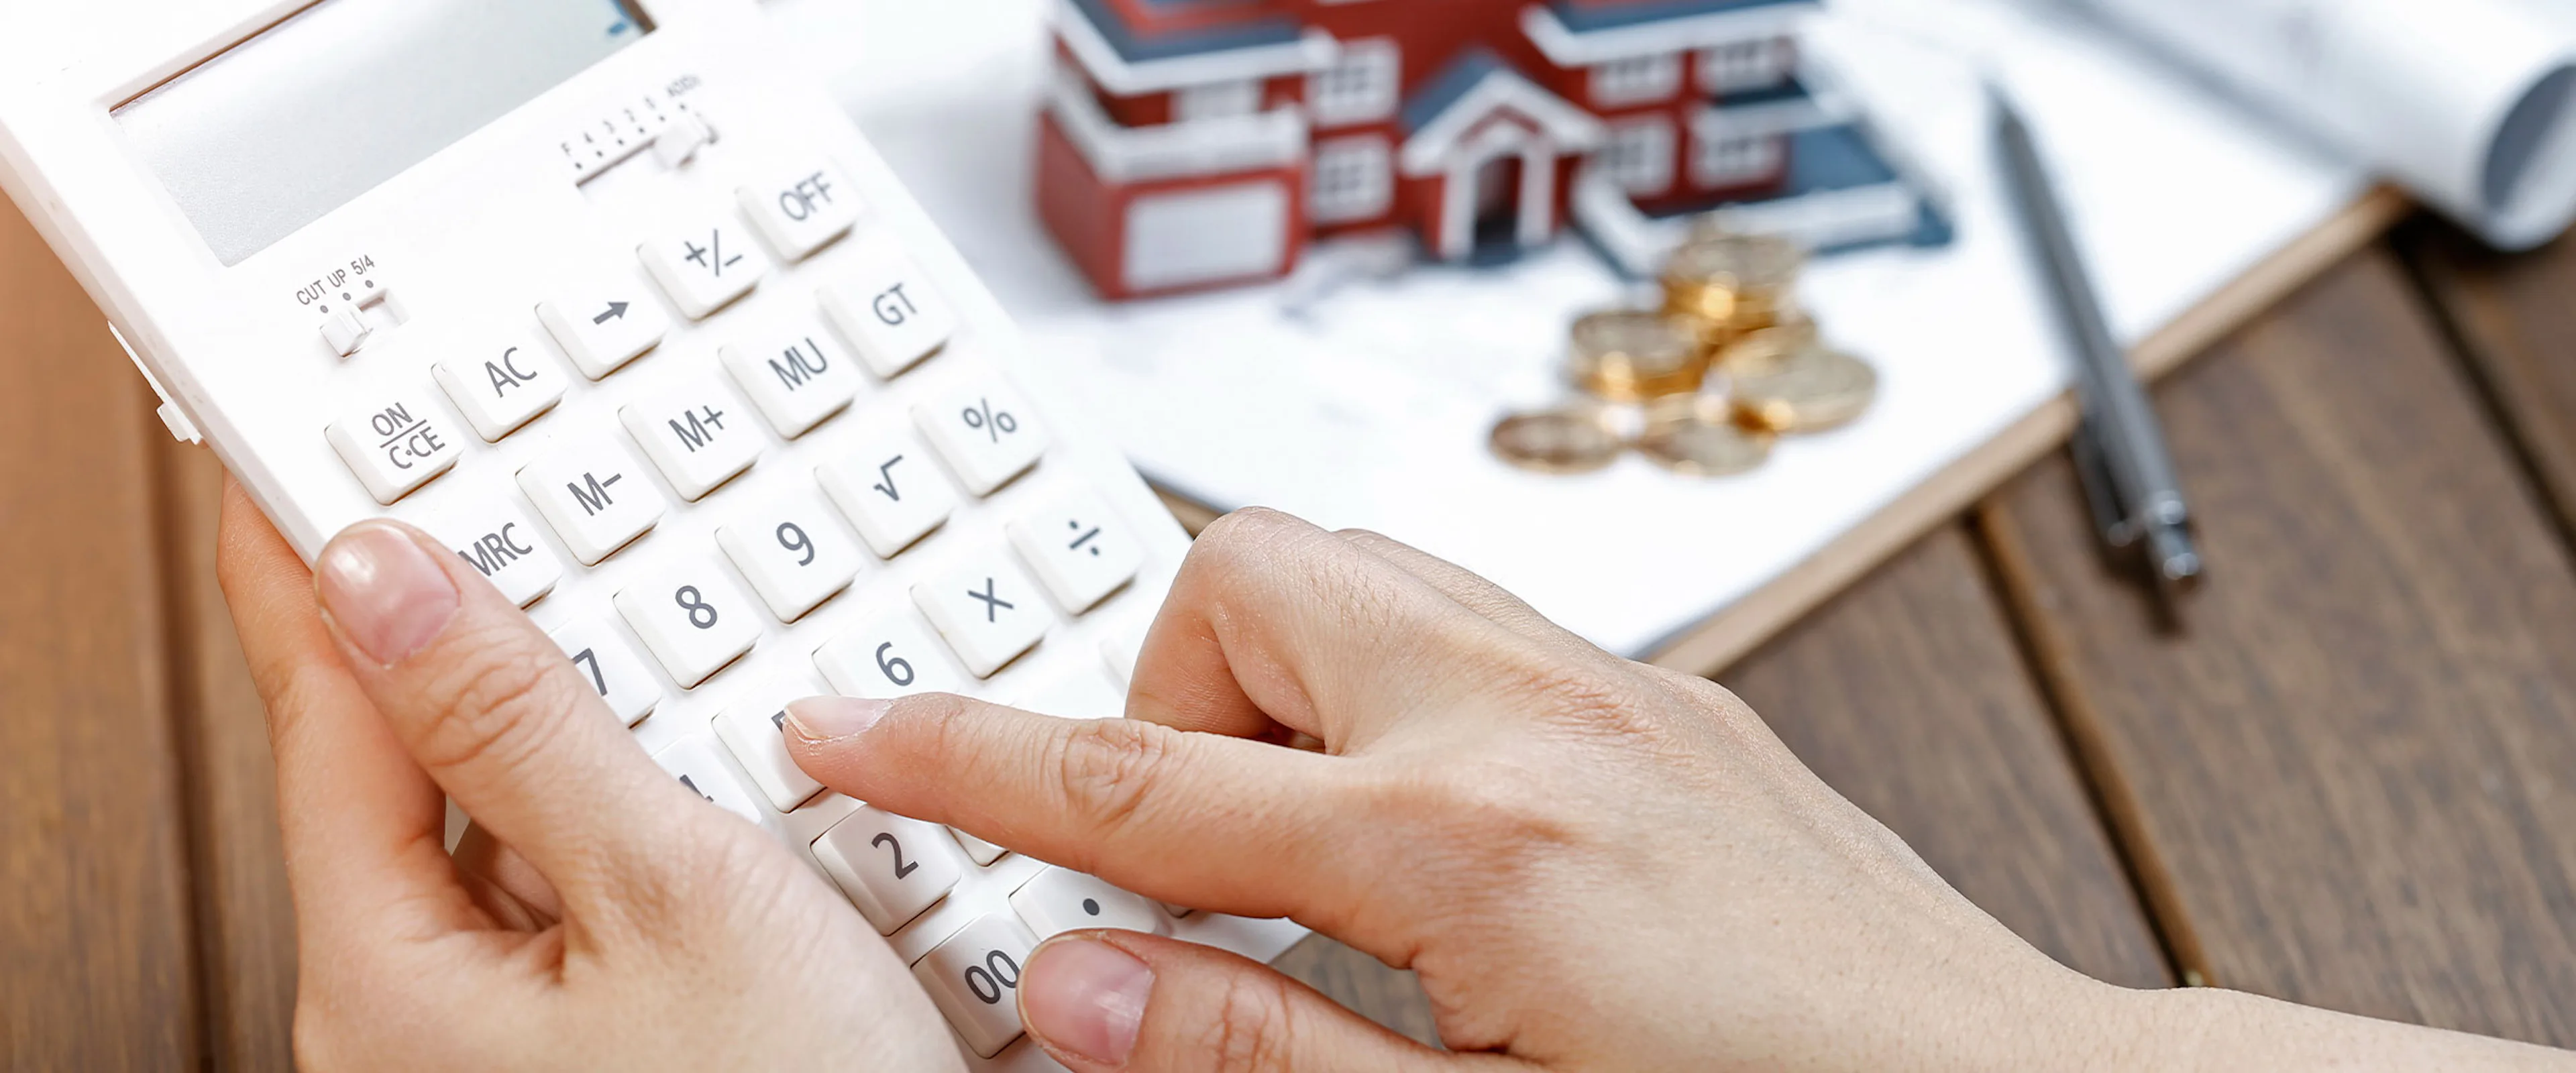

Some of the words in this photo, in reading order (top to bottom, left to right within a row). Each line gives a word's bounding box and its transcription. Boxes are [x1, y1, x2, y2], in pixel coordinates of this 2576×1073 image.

[779, 170, 833, 222] OFF
[296, 279, 327, 306] CUT
[327, 268, 346, 288] UP
[350, 254, 375, 275] 5/4
[872, 282, 918, 327] GT
[484, 346, 538, 398] AC
[767, 337, 828, 392] MU
[372, 402, 413, 437] ON
[667, 405, 724, 453] M+
[566, 471, 622, 517] M-
[457, 522, 533, 577] MRC
[775, 522, 815, 567] 9
[675, 585, 718, 630] 8
[571, 647, 608, 697] 7
[875, 641, 914, 687] 6
[871, 832, 919, 880] 2
[964, 949, 1020, 1005] 00
